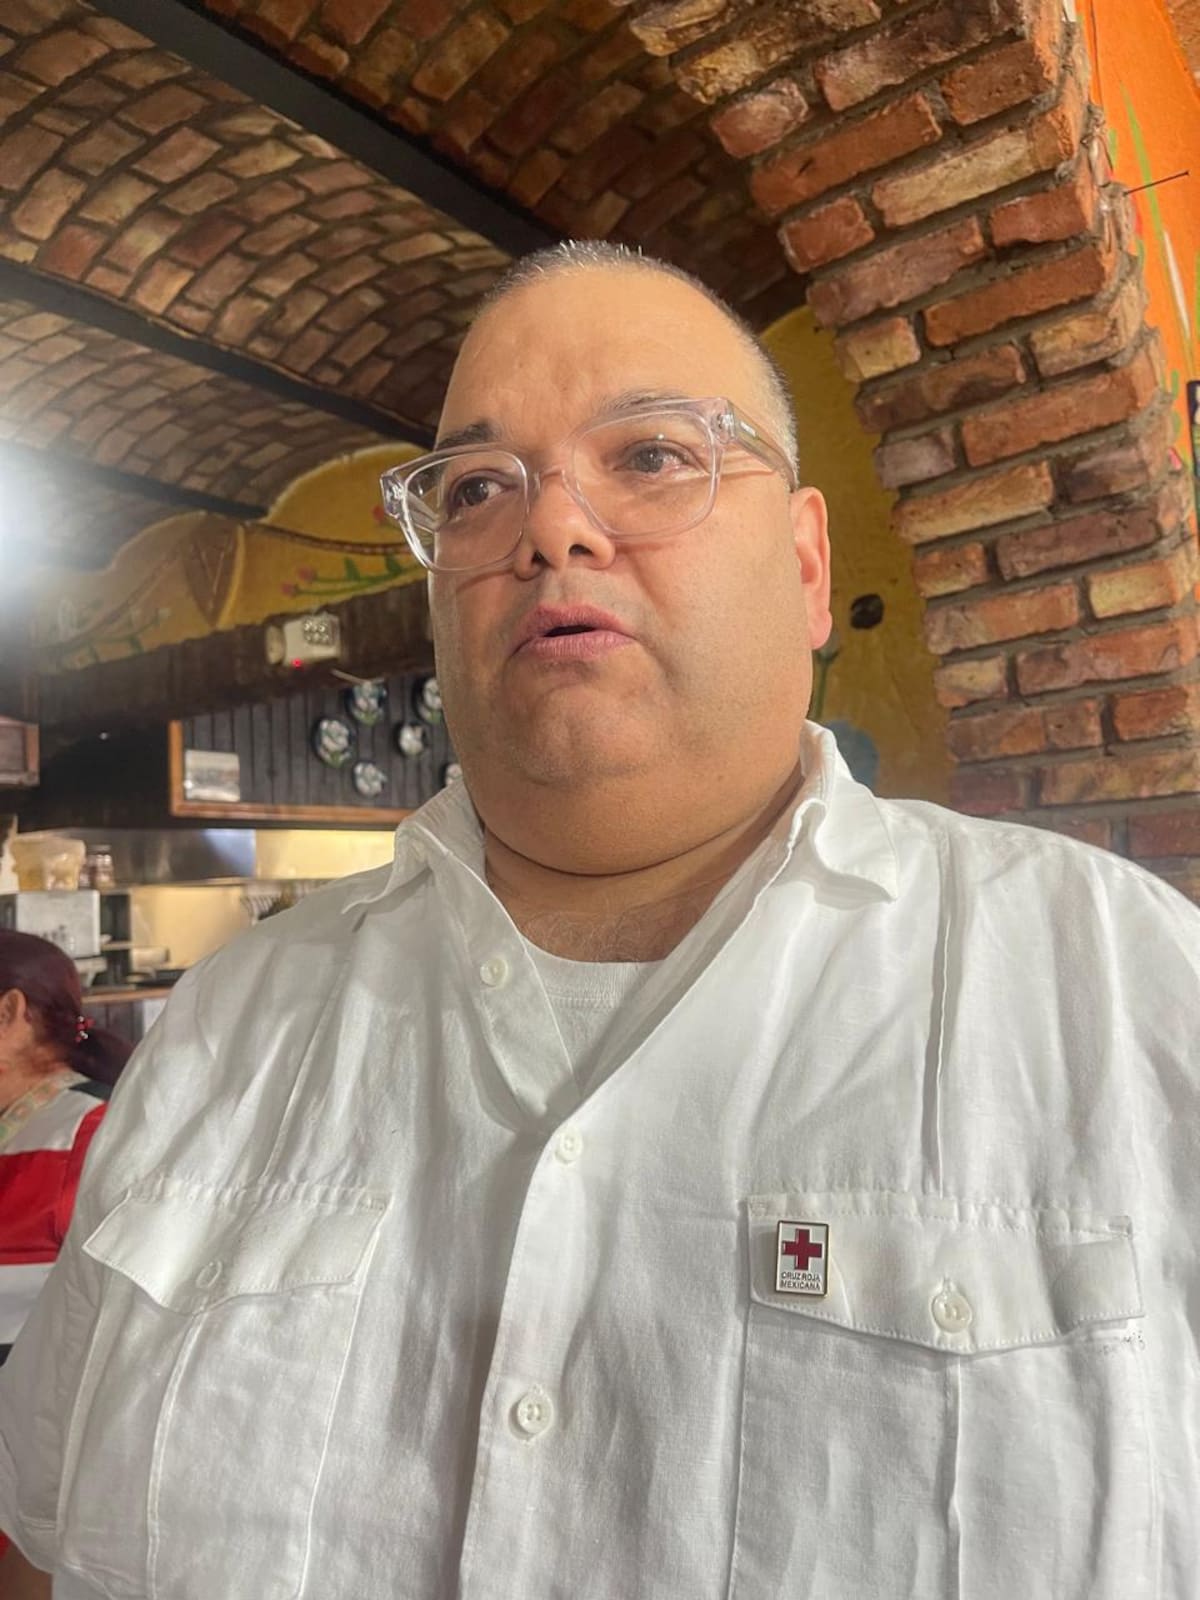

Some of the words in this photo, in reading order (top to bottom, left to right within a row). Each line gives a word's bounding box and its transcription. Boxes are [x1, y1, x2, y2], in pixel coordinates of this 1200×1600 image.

[781, 1271, 800, 1281] CRUZ
[801, 1272, 820, 1282] ROJA
[780, 1280, 820, 1290] MEXICANA
